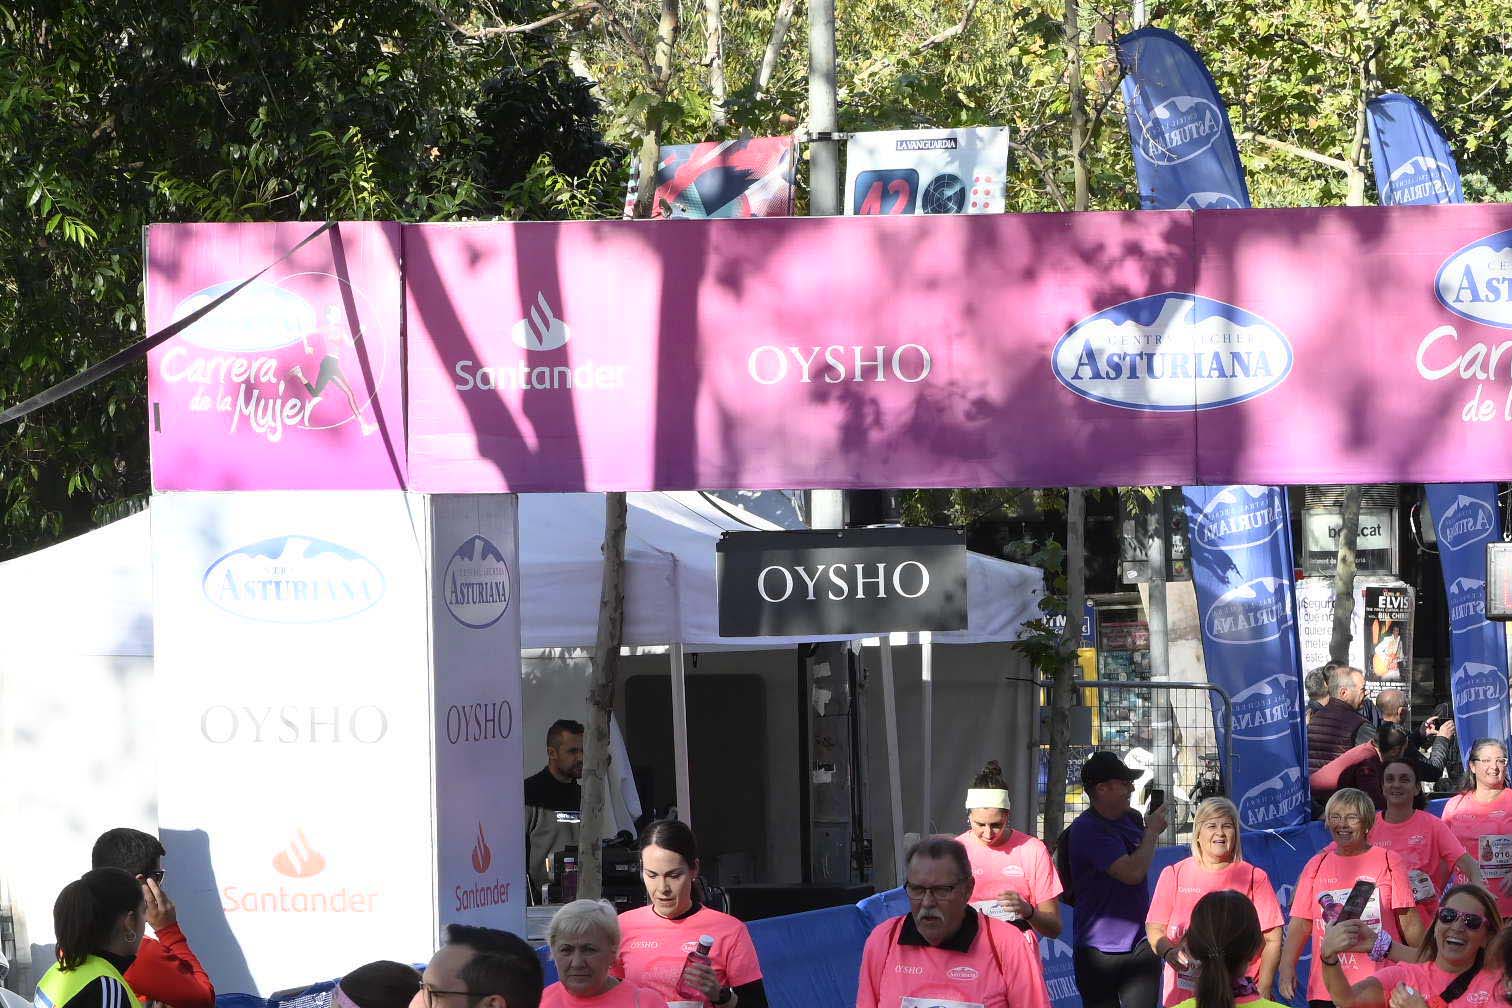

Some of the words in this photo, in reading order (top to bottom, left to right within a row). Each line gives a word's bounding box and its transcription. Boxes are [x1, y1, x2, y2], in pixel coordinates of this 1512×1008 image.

[160, 346, 278, 384] Carrera
[455, 360, 625, 392] Santander
[748, 343, 932, 385] OYSHO
[1071, 338, 1275, 381] ASTURIANA
[216, 386, 233, 412] la
[230, 379, 324, 443] Mujer
[1461, 383, 1497, 423] de
[217, 568, 373, 602] ASTURIANA
[448, 569, 508, 605] ASTURIANA
[757, 561, 930, 602] OYSHO
[1378, 596, 1409, 609] ELVIS
[201, 704, 388, 744] OYSHO
[446, 700, 512, 744] OYSHO
[222, 886, 378, 914] Santander
[455, 881, 511, 913] Santander
